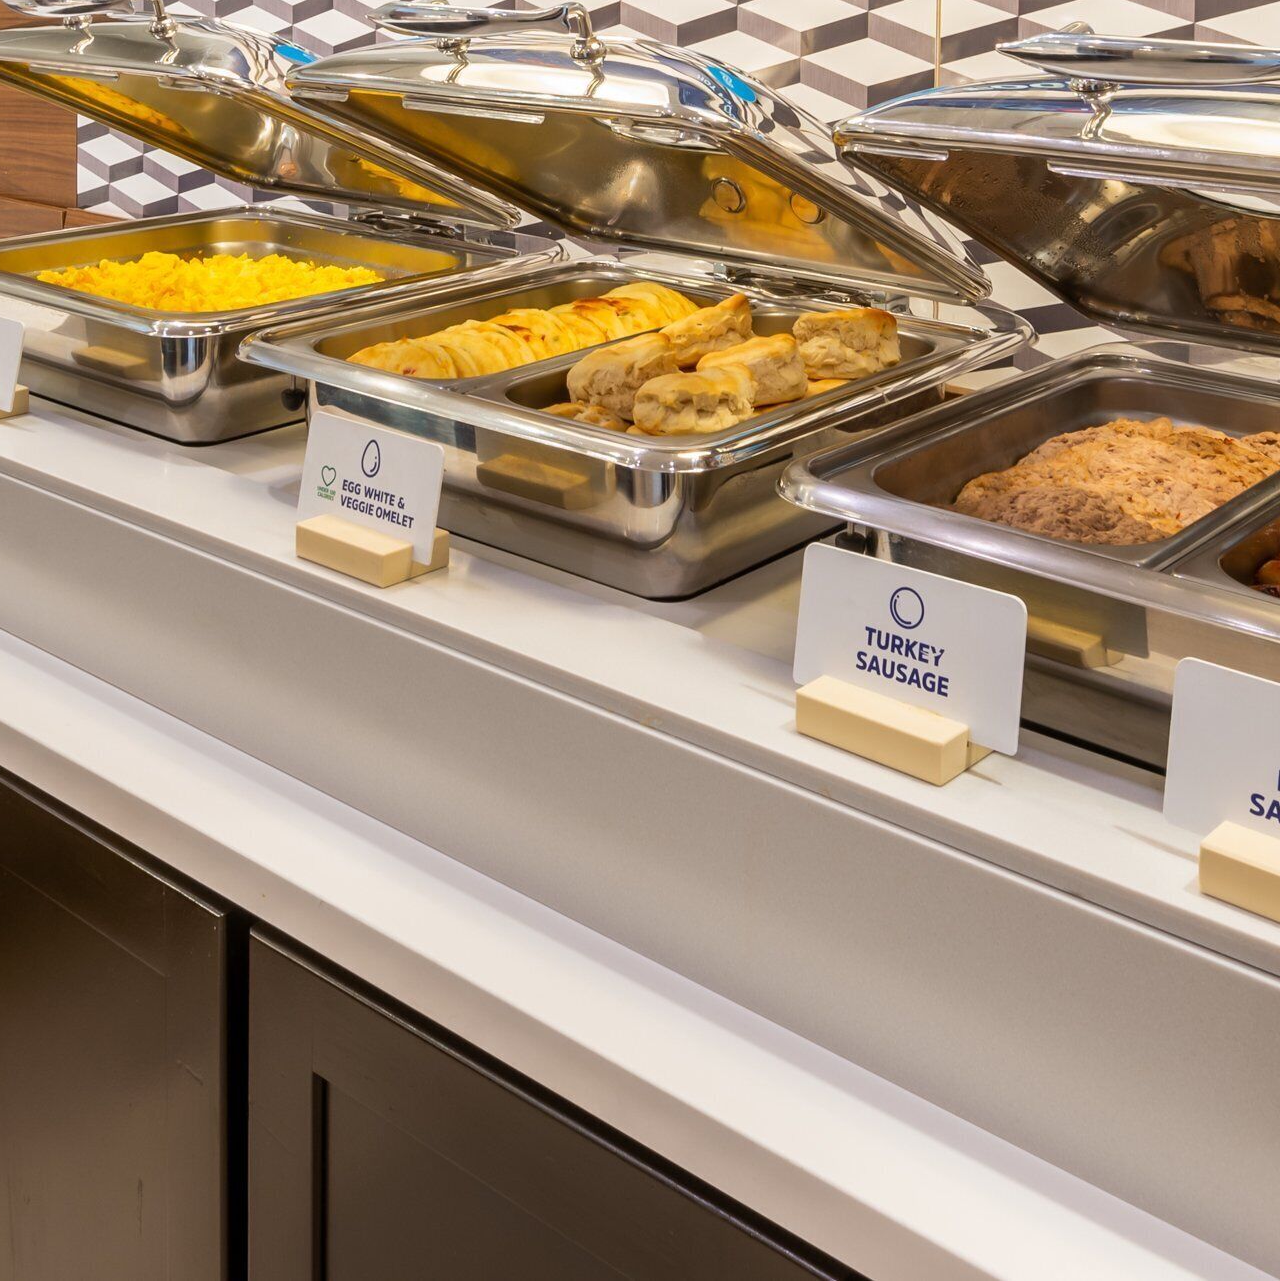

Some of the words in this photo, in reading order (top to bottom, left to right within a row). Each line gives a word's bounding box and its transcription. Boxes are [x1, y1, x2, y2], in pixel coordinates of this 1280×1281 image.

[340, 494, 374, 516] VEGGIE
[376, 506, 414, 528] OMELET
[342, 479, 361, 495] EGG
[364, 486, 395, 506] WHITE
[397, 497, 405, 509] &
[865, 626, 944, 667] TURKEY
[855, 651, 949, 697] SAUSAGE
